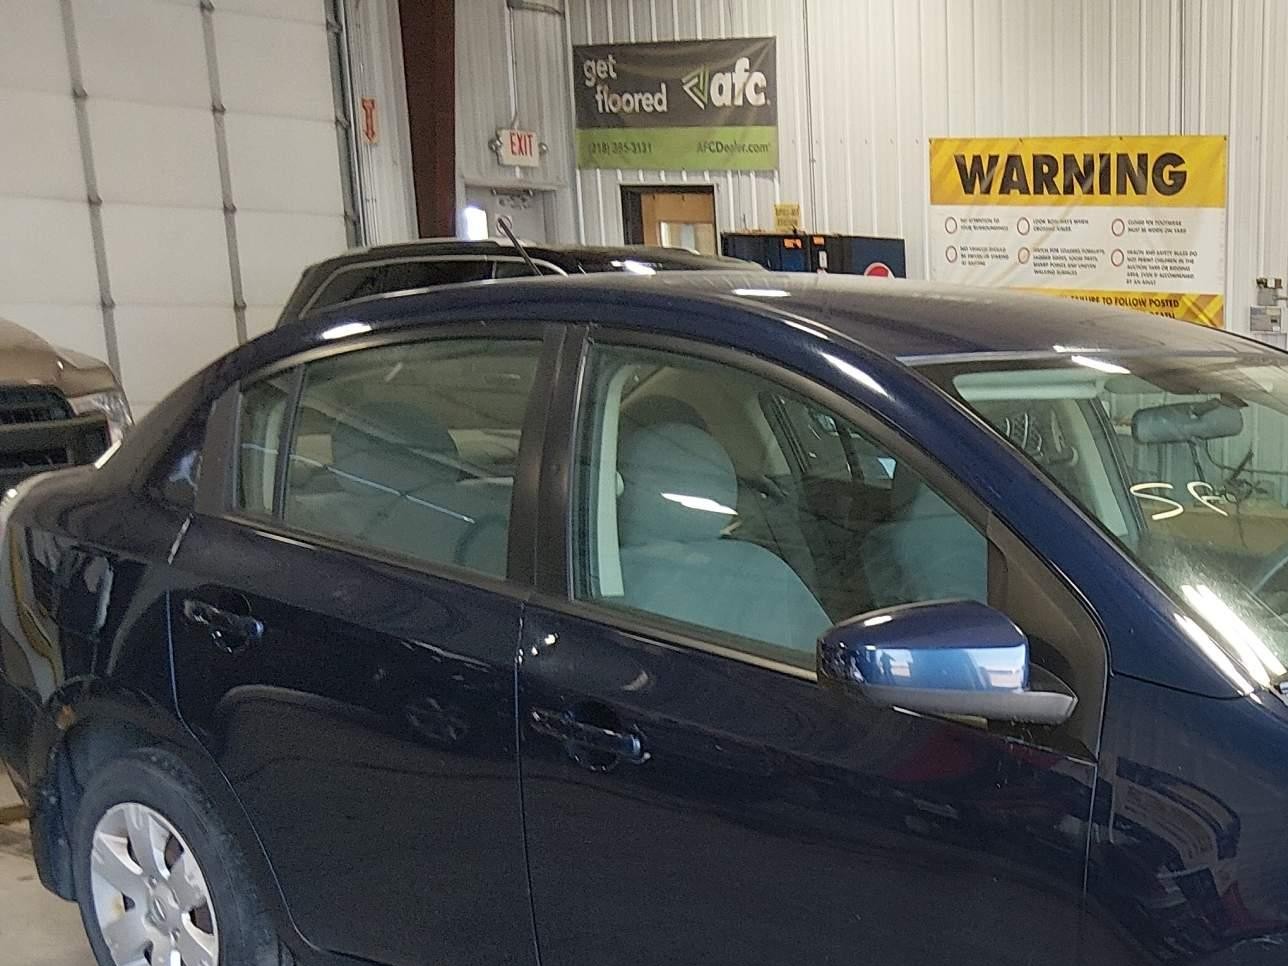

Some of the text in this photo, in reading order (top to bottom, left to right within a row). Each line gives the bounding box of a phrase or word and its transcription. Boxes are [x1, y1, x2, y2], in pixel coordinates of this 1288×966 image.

[583, 54, 617, 87] get
[595, 82, 668, 114] floored
[509, 131, 534, 157] EXIT
[953, 152, 1188, 196] WARNING
[1102, 296, 1113, 306] TO
[1114, 296, 1147, 308] FOLLOW
[1148, 298, 1180, 308] POSTED
